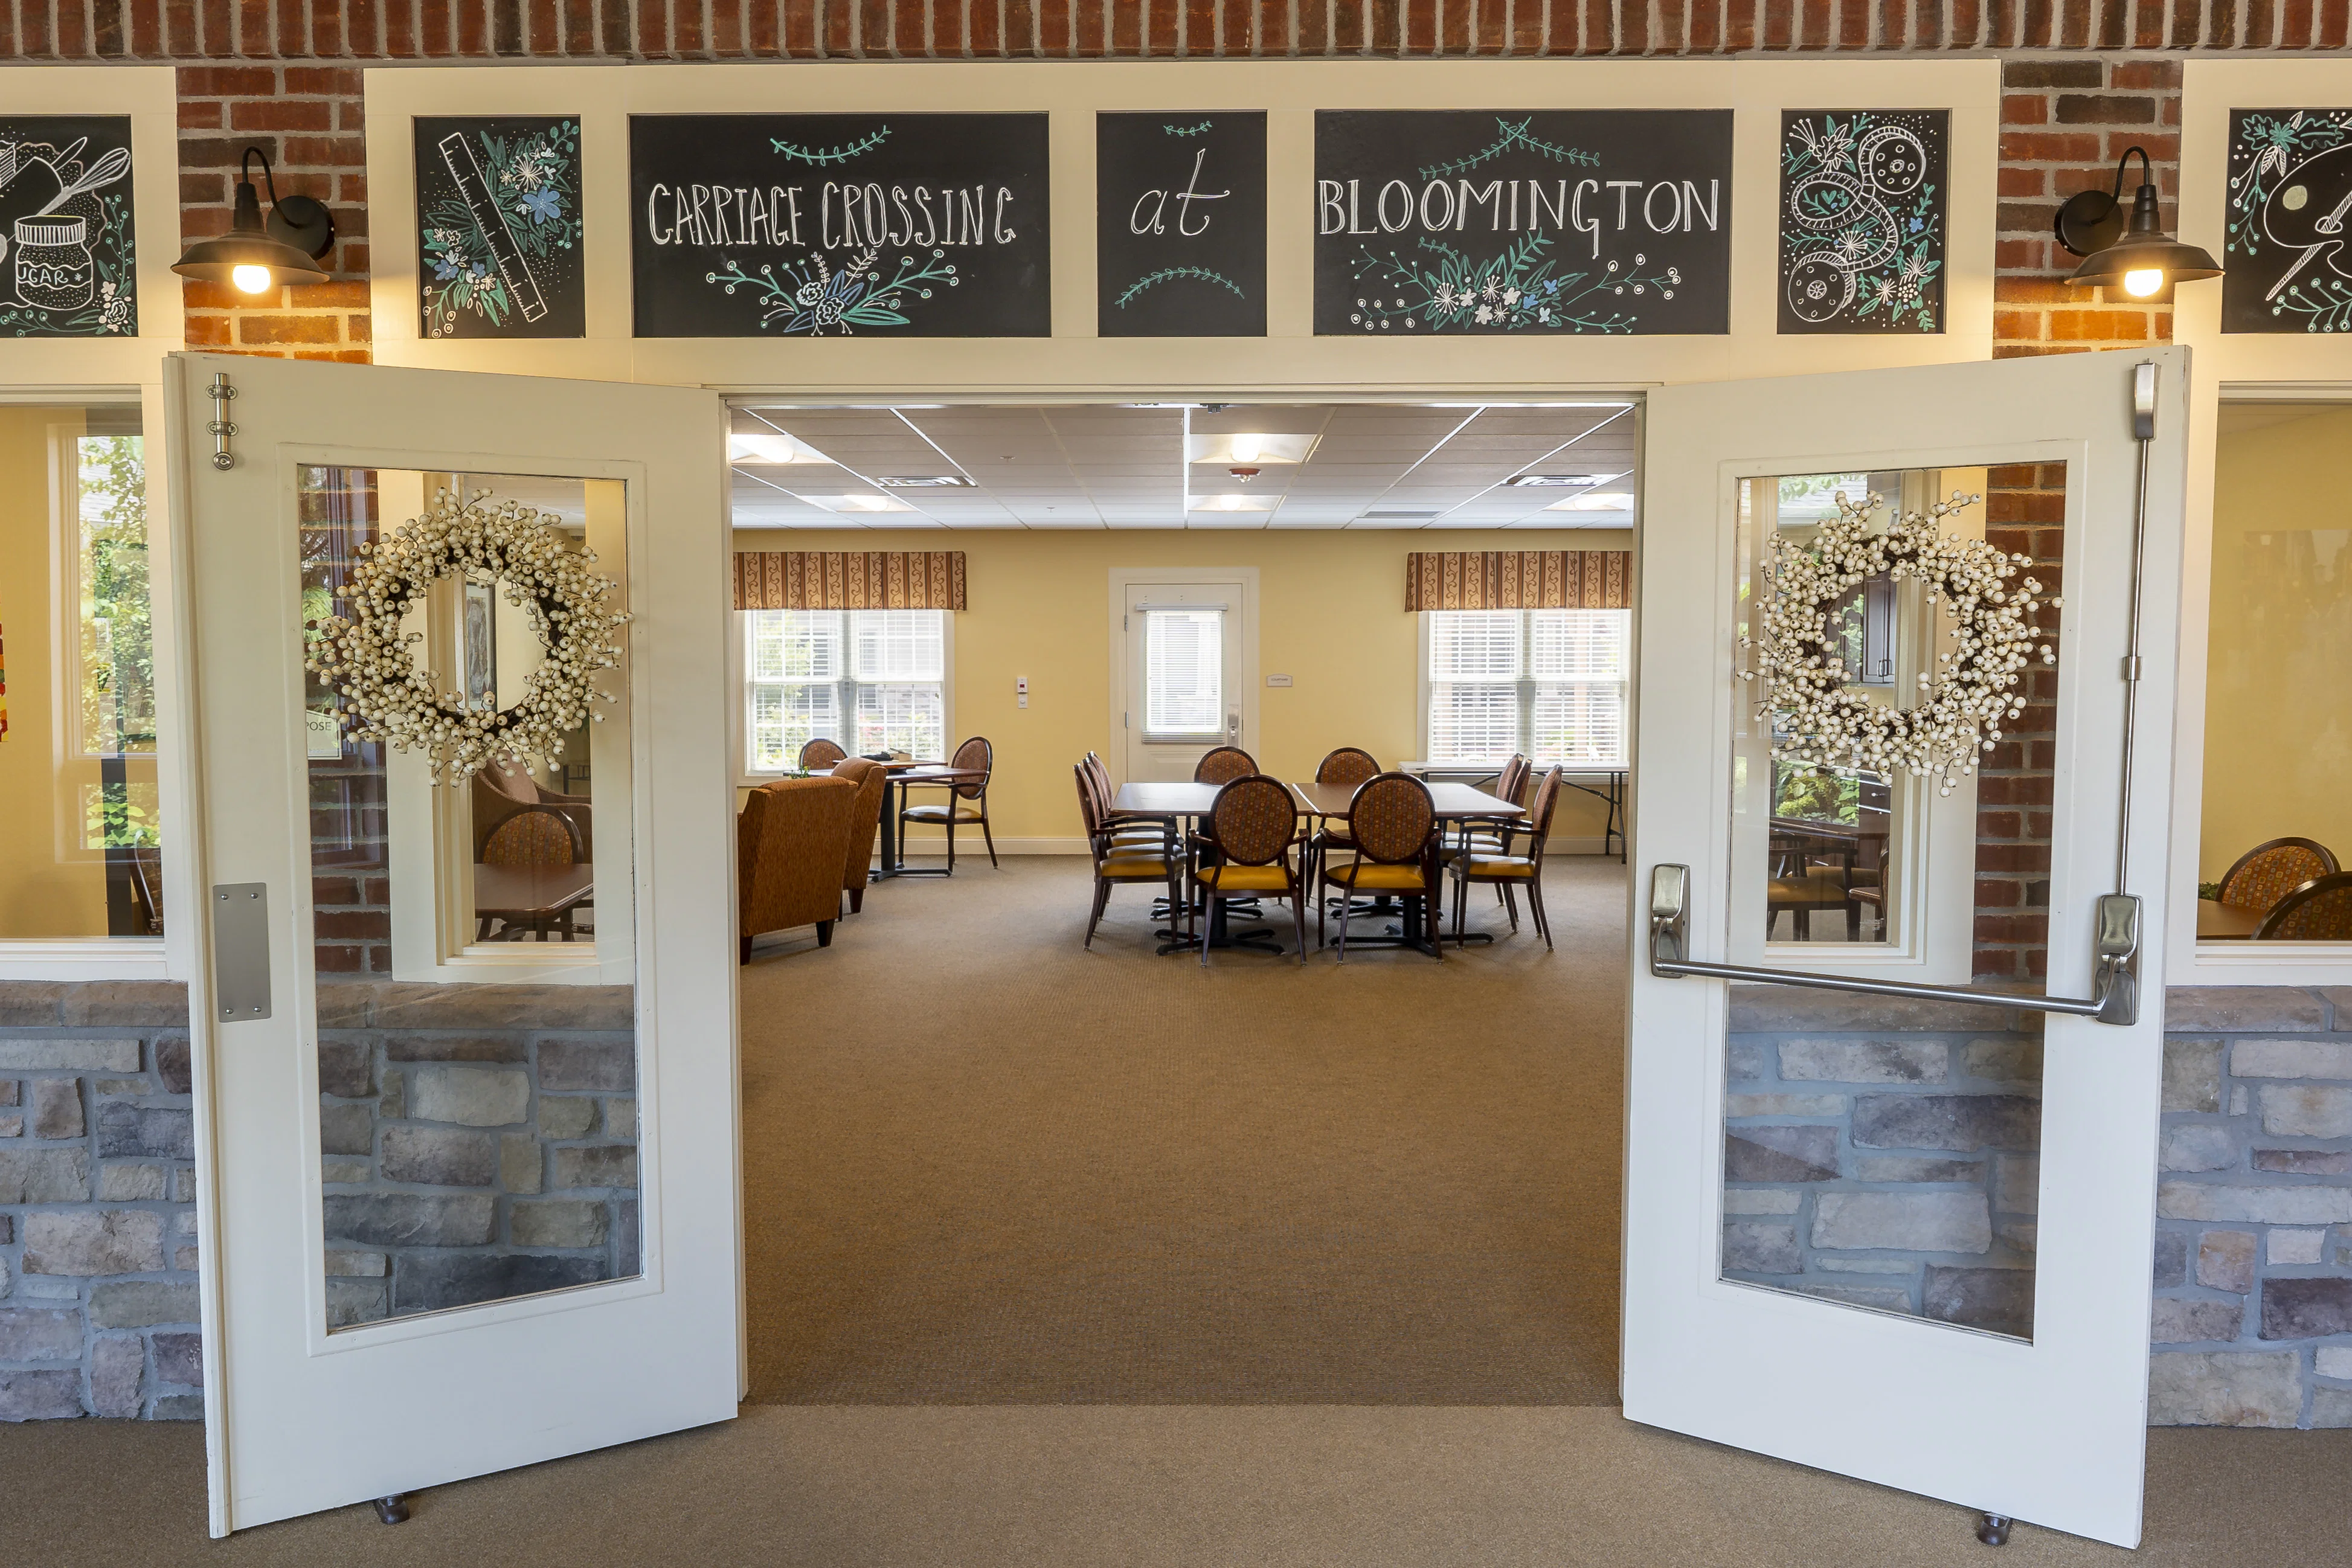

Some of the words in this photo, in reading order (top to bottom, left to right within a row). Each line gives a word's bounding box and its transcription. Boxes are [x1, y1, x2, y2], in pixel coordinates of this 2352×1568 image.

[649, 183, 806, 246] CARRIAGE
[823, 182, 1016, 249] CROSSING
[1131, 148, 1230, 236] at
[1318, 179, 1719, 259] BLOOMINGTON
